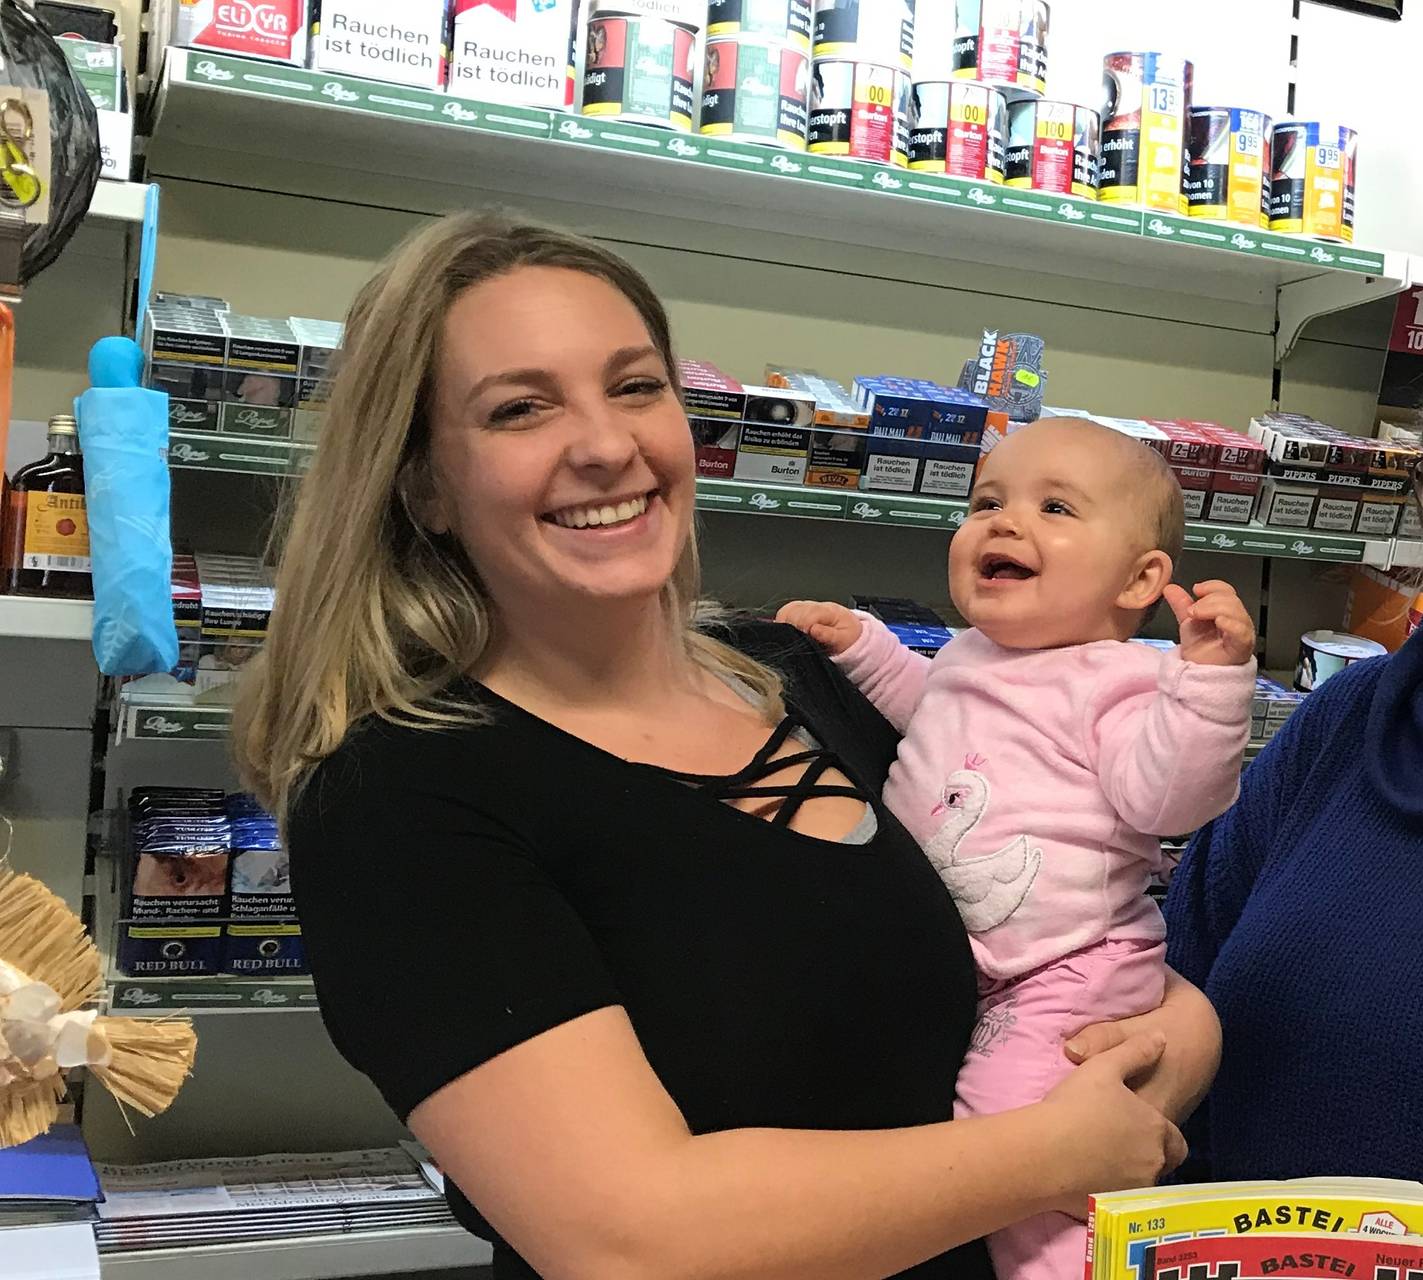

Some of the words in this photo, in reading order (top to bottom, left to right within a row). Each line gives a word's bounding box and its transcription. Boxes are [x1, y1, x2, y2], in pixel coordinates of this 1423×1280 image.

[332, 14, 429, 46] Rauchen
[325, 35, 351, 55] ist
[360, 41, 433, 69] tödlich
[463, 41, 556, 68] Rauchen
[457, 63, 481, 79] ist
[489, 67, 560, 90] tödlich
[809, 111, 847, 126] erstopft
[908, 130, 943, 145] erstopft
[1103, 138, 1134, 152] erhöht
[974, 327, 999, 395] BLACK
[987, 338, 1010, 398] HAWK
[699, 459, 729, 470] Burton
[876, 457, 910, 467] Rauchen
[933, 462, 966, 473] Rauchen
[771, 465, 800, 476] Burton
[873, 464, 883, 472] ist
[883, 465, 911, 475] tödlich
[929, 470, 939, 478] ist
[939, 470, 966, 480] tödlich
[1284, 469, 1317, 481] PIPERS
[1328, 474, 1361, 485] PIPERS
[1371, 479, 1404, 490] PIPERS
[1217, 496, 1249, 506] Rauchen
[1278, 498, 1309, 507] Rauchen
[133, 898, 170, 908] Rauchen
[172, 897, 219, 908] verursacht
[202, 905, 219, 914] und
[134, 960, 167, 971] RED
[168, 959, 208, 971] BULL
[232, 958, 264, 970] RED
[265, 957, 302, 969] BULL
[1128, 1221, 1144, 1234] Nr.
[1147, 1217, 1166, 1231] 133
[1233, 1205, 1345, 1234] BASTEI
[1375, 1216, 1394, 1230] ALLE
[1260, 1252, 1356, 1277] BASTEI
[1375, 1252, 1416, 1268] Neuer
